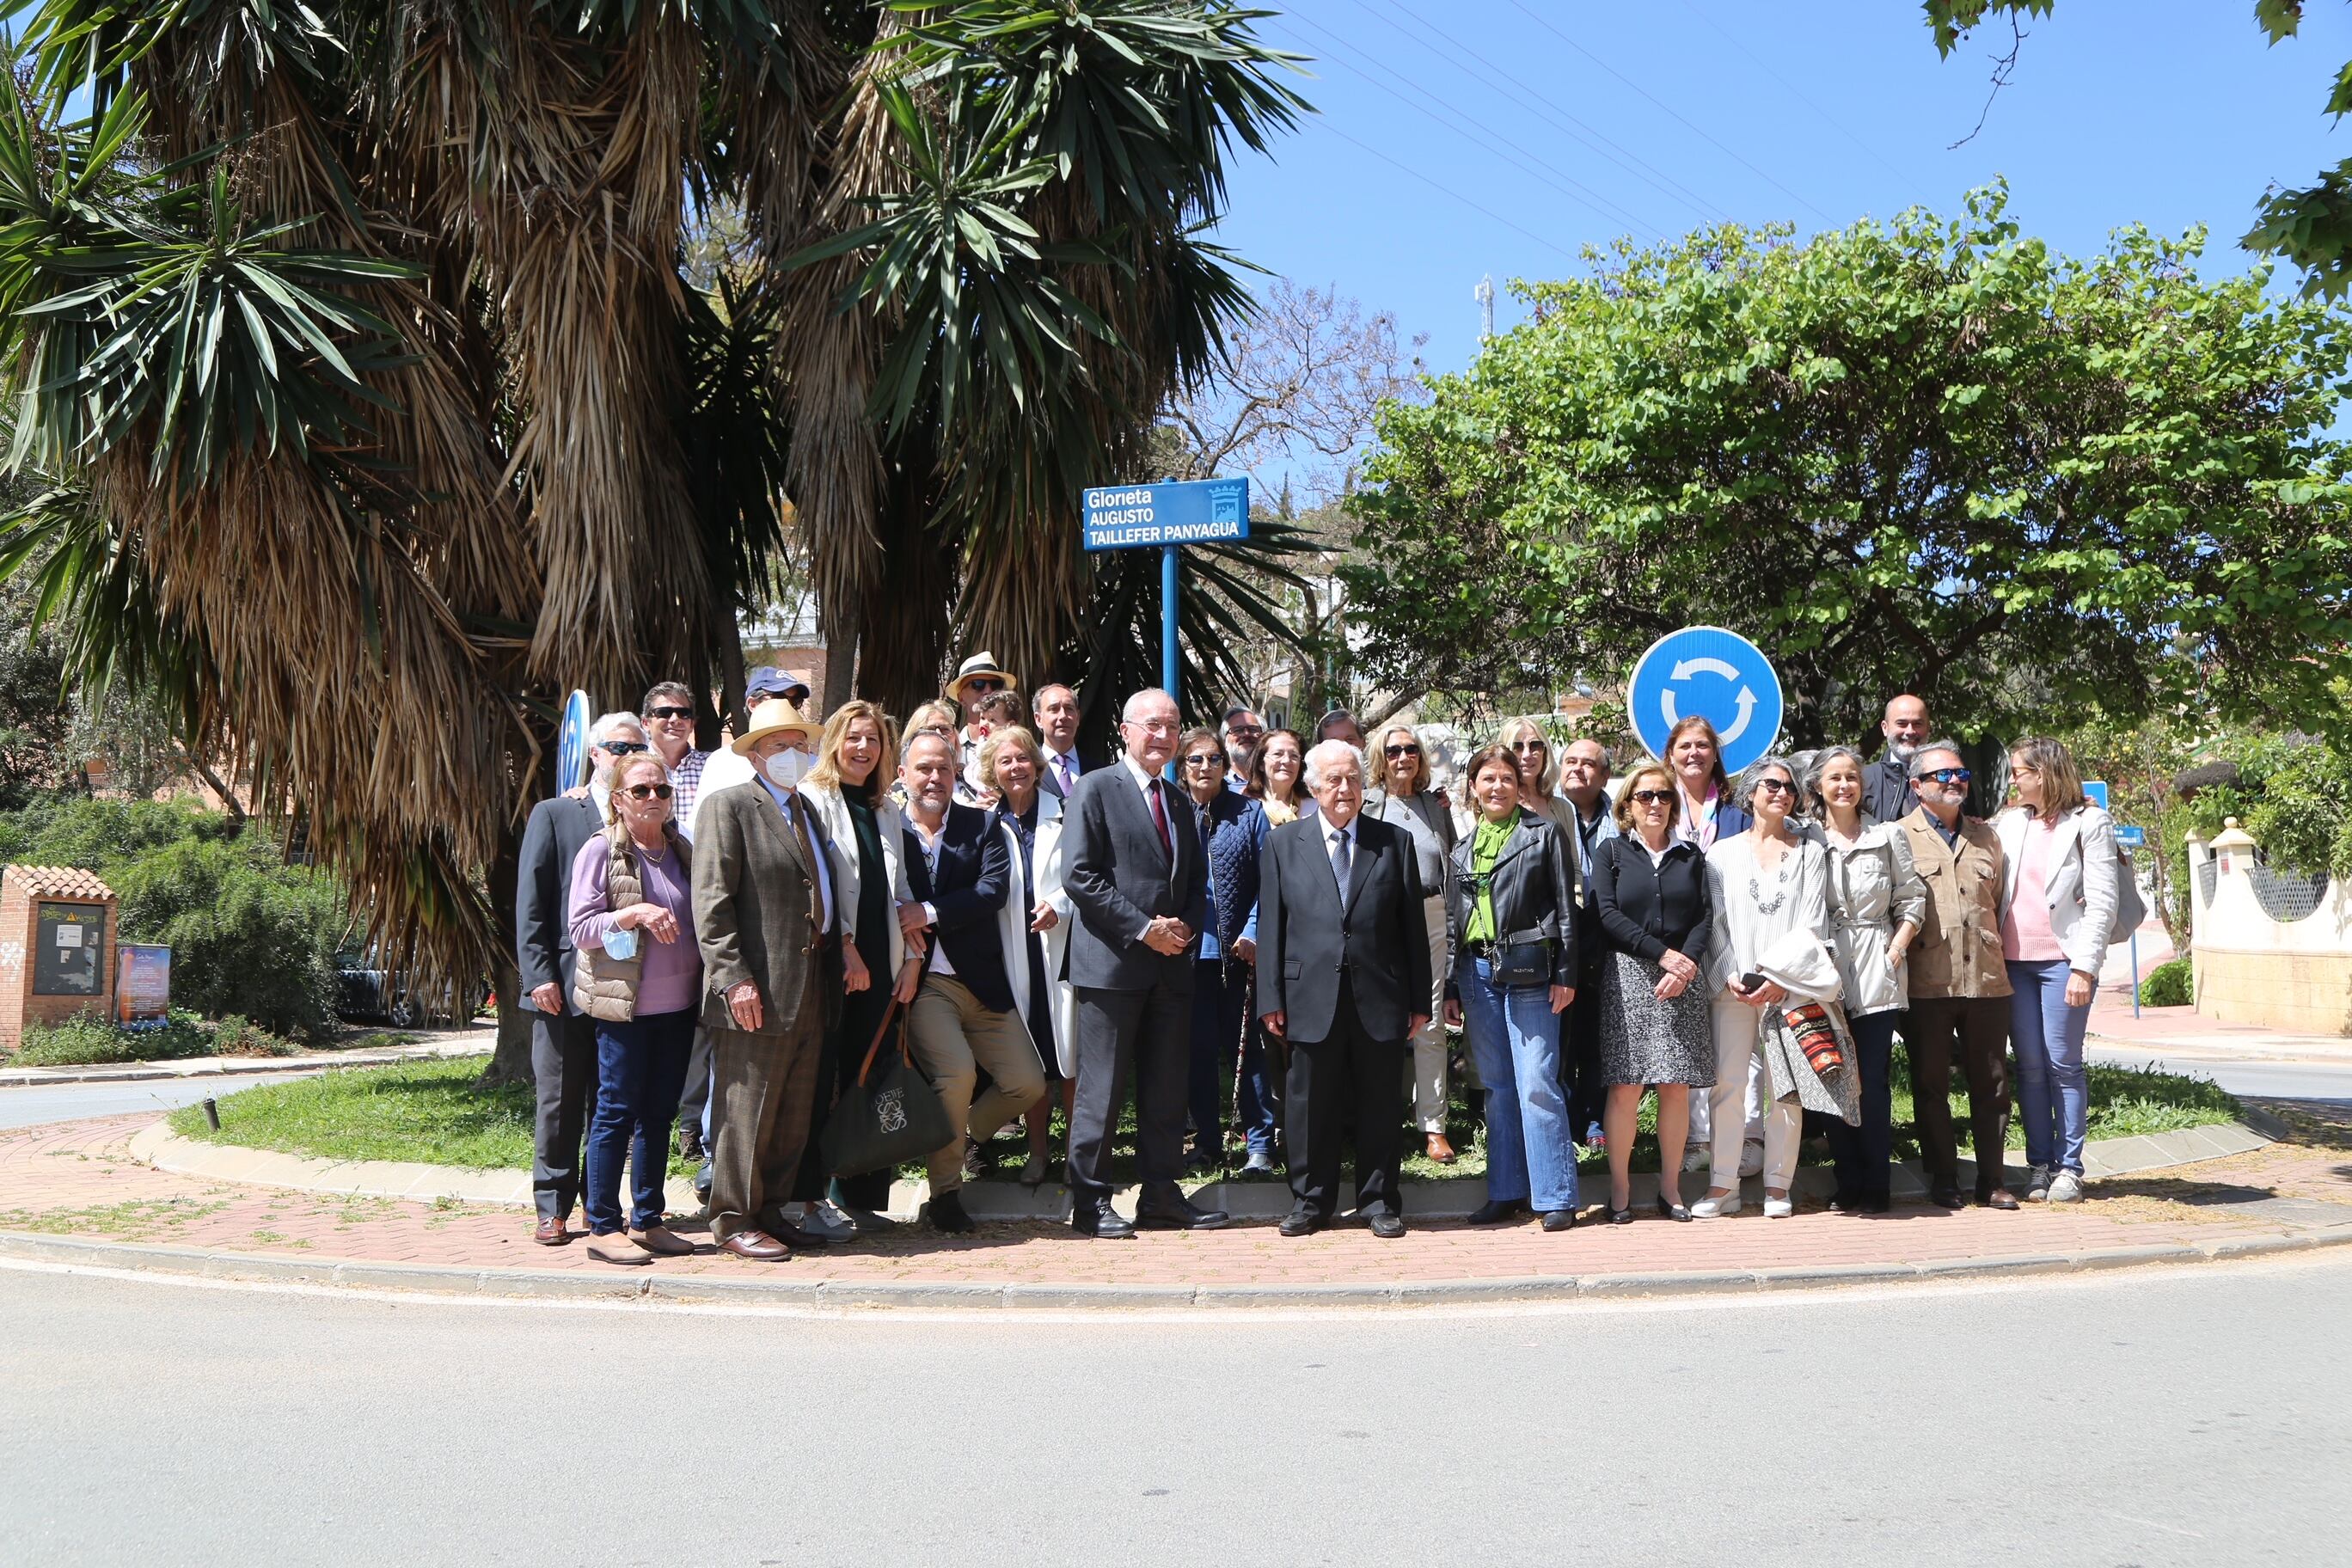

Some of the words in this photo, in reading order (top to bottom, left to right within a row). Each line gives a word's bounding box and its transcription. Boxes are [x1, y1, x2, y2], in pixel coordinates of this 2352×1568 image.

[1088, 489, 1152, 509] Glorieta
[1089, 508, 1154, 526] AUGUSTO
[1089, 527, 1161, 545] TAILLEFER
[1164, 522, 1239, 540] PANYAGUA
